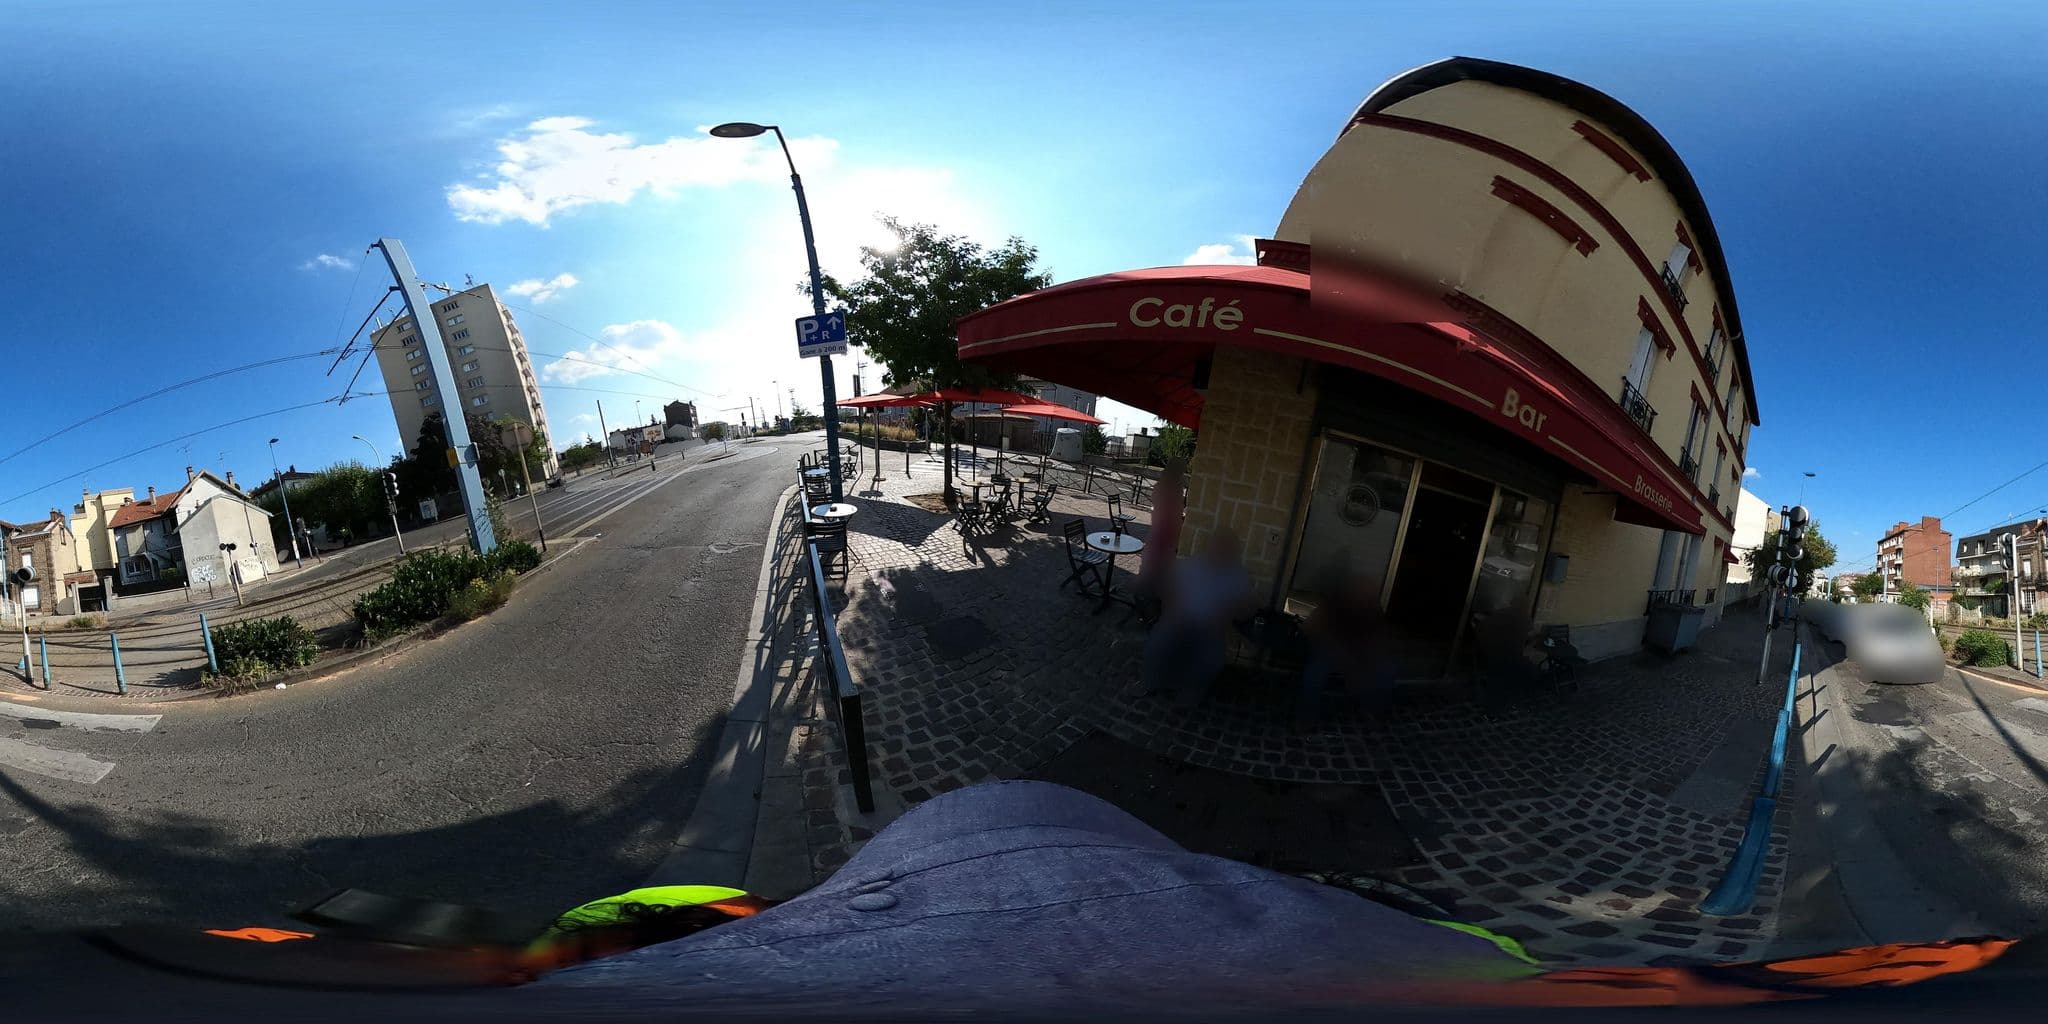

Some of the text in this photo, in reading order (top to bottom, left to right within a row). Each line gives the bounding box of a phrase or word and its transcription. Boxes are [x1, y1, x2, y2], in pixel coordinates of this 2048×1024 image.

[823, 345, 837, 353] 200
[1129, 297, 1673, 513] Café Bar Brasserie
